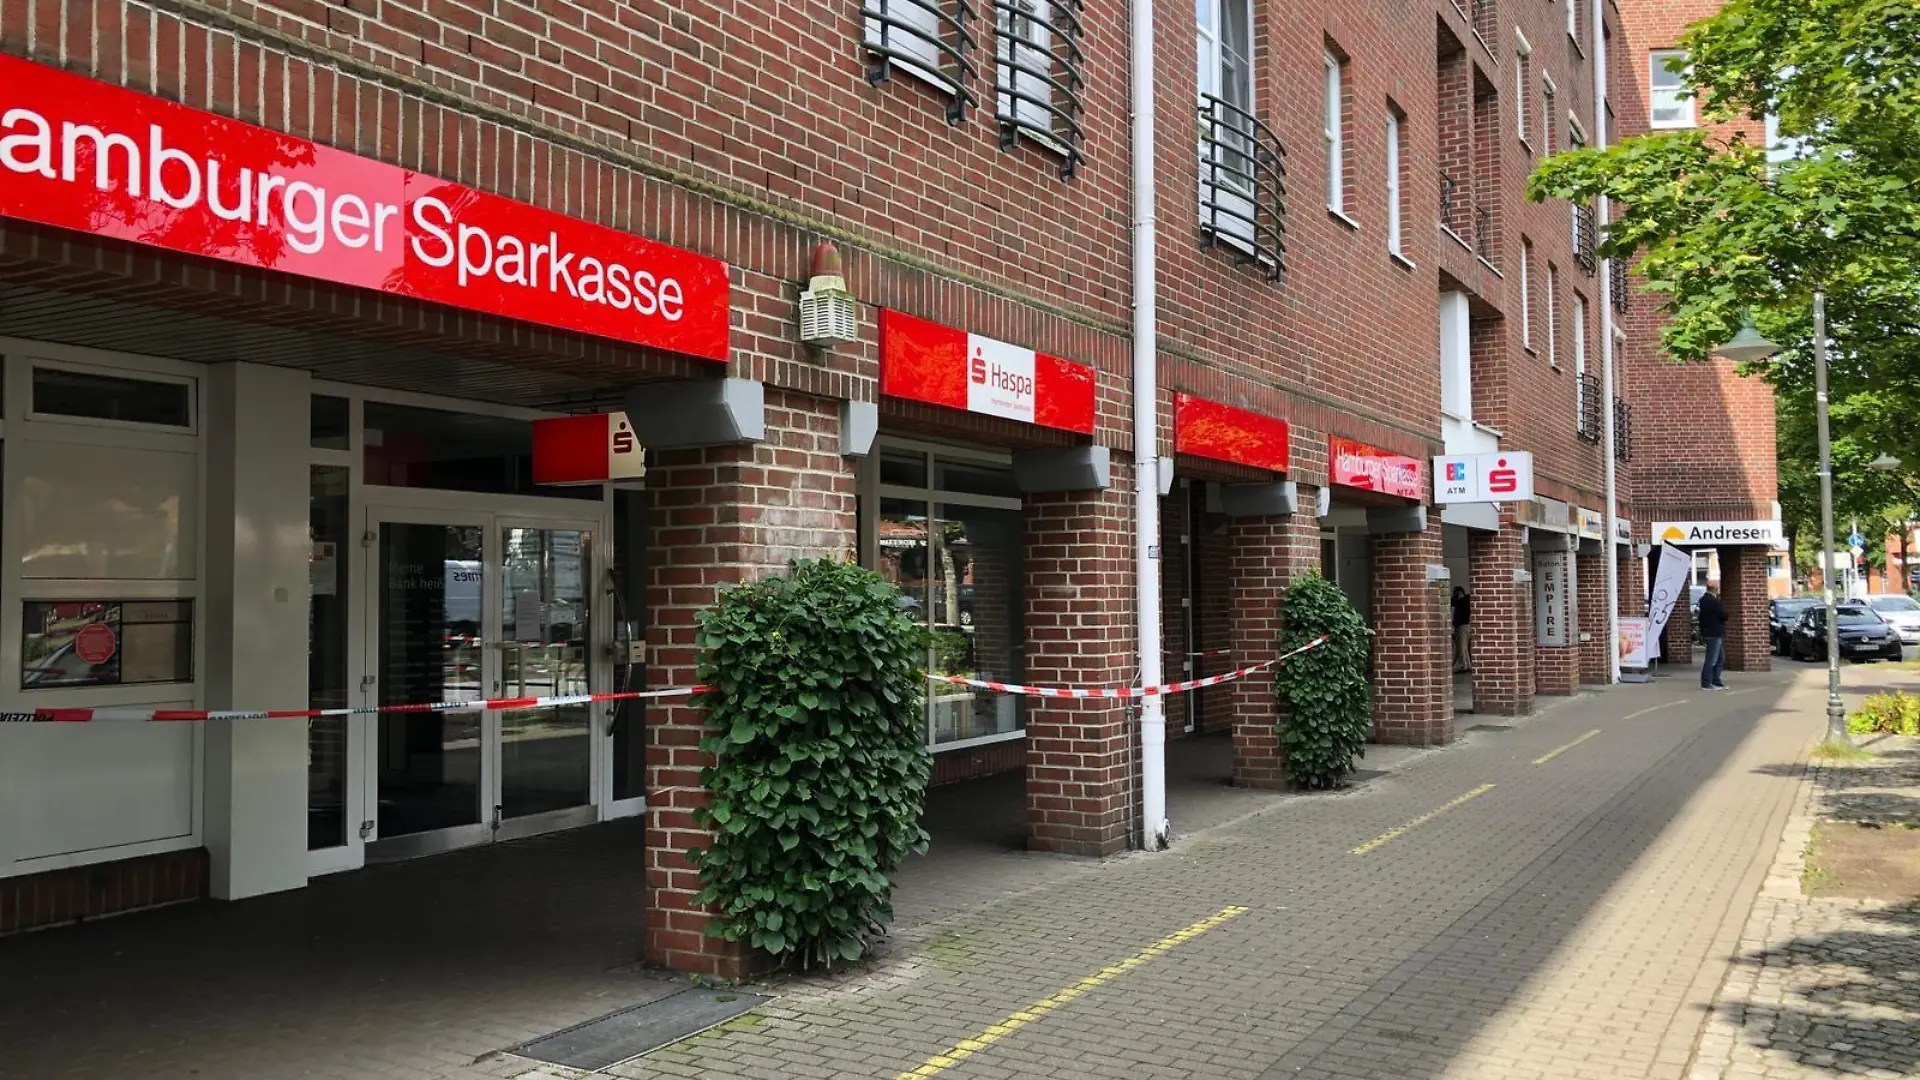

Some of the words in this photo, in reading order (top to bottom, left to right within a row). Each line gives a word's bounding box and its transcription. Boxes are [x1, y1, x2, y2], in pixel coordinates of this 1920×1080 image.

[410, 196, 684, 321] Sparkasse
[991, 363, 1032, 399] Haspa
[1447, 486, 1466, 494] ATM
[1689, 525, 1772, 540] Andresen
[1544, 571, 1556, 637] EMPIRE
